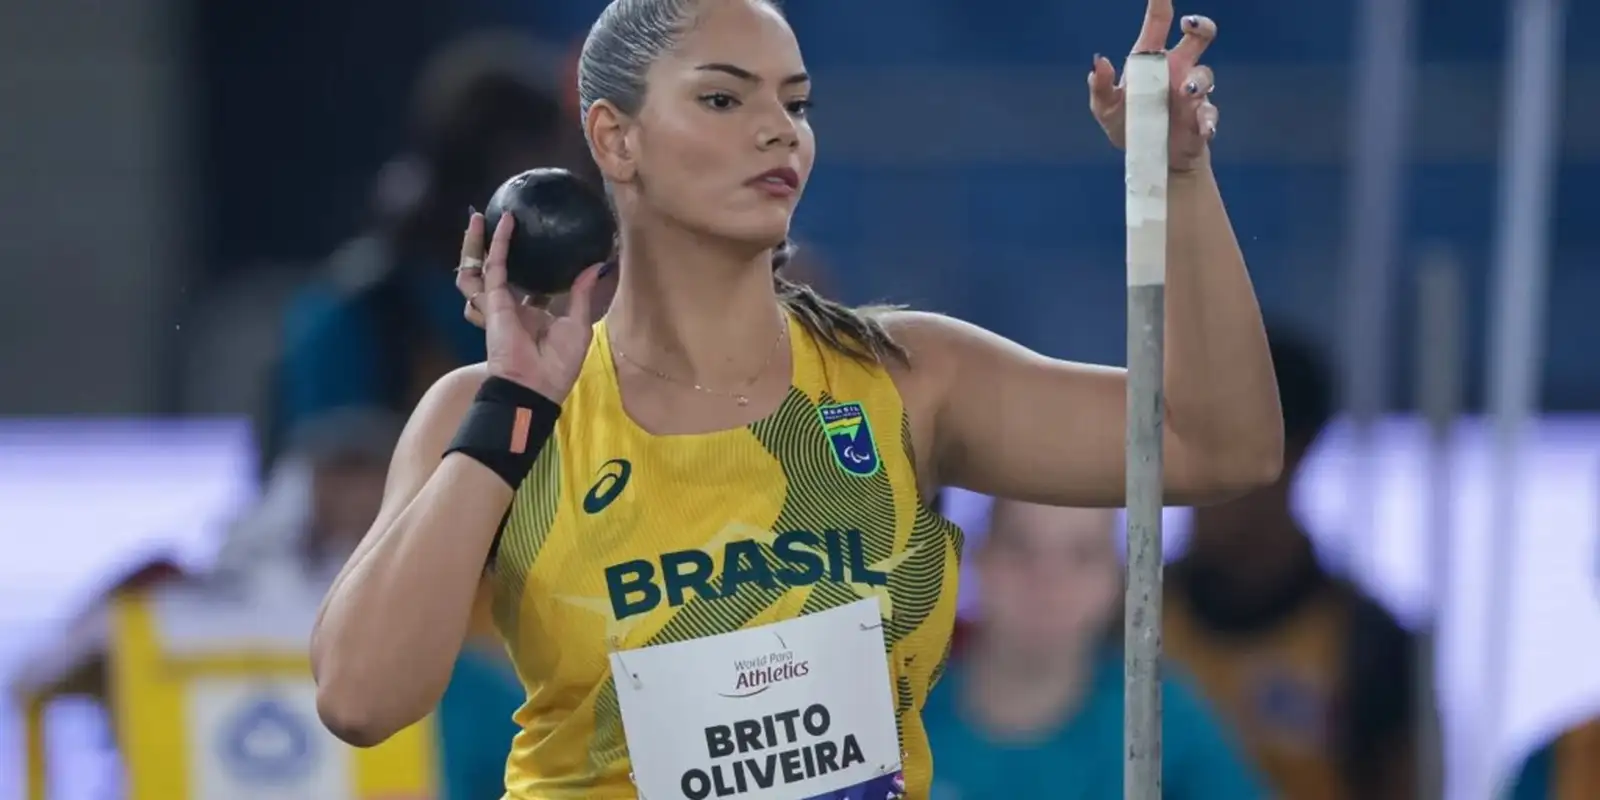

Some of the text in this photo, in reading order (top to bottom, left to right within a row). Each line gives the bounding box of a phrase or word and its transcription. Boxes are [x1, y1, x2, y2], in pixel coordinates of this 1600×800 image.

[604, 529, 887, 620] BRASIL
[734, 651, 793, 671] World Para
[736, 660, 809, 689] Athletics
[704, 703, 831, 758] BRITO
[680, 733, 866, 800] OLIVEIRA
